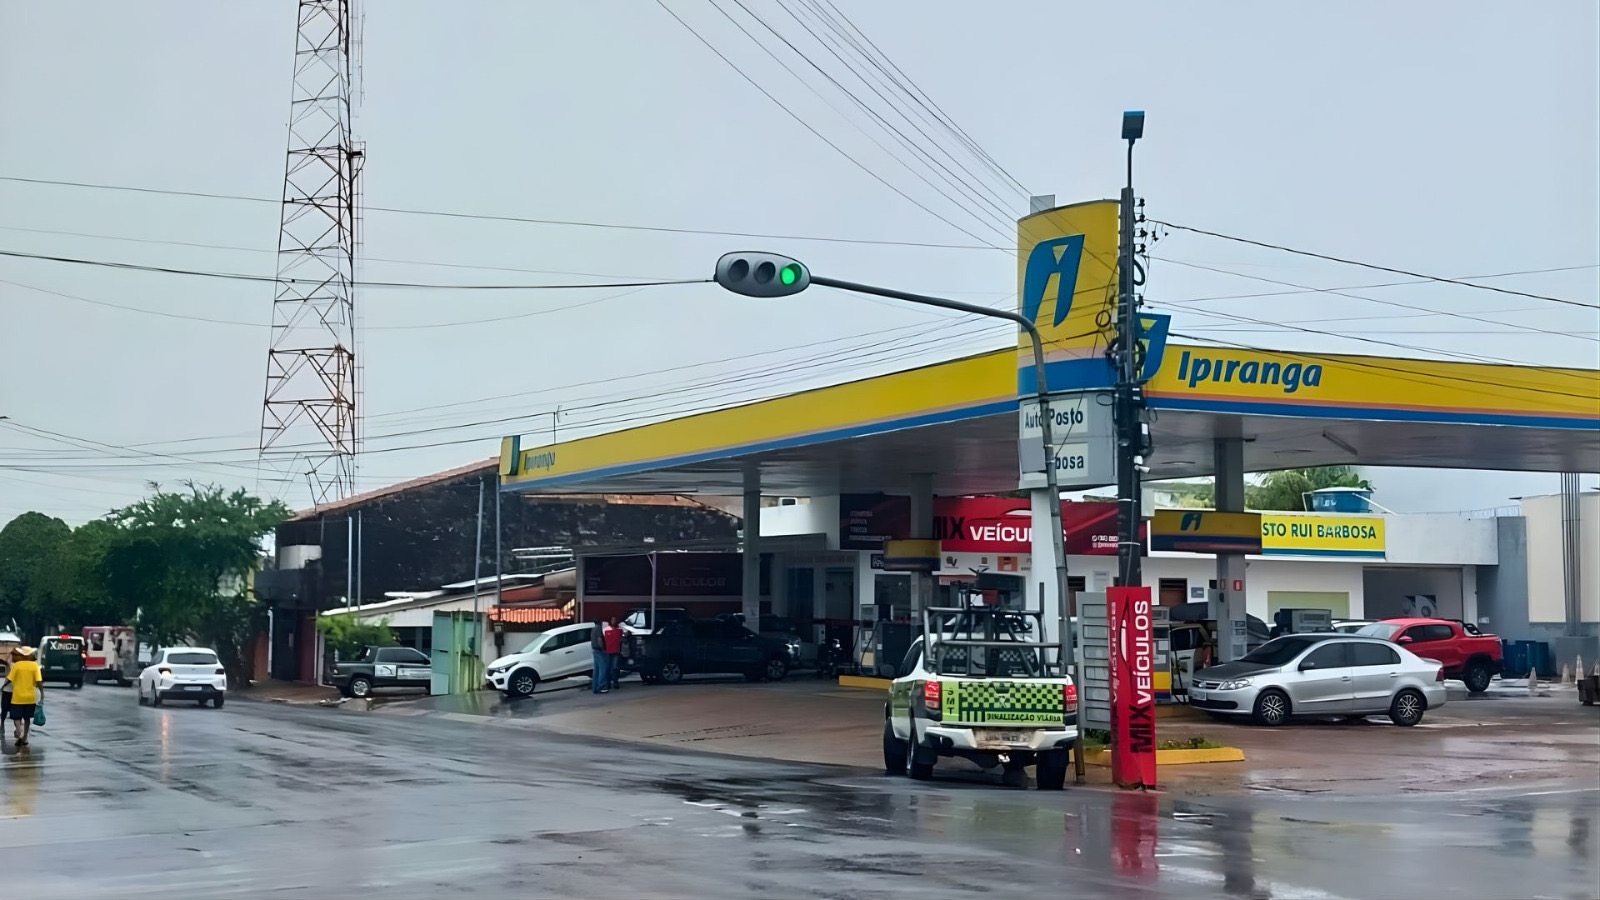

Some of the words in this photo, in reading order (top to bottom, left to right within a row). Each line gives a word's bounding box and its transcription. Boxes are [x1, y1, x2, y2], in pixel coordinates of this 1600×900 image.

[1177, 351, 1322, 393] Ipiranga
[1291, 524, 1312, 537] RUI
[1317, 525, 1377, 539] BARBOSA
[1132, 600, 1151, 705] VEÍCULOS
[1129, 704, 1152, 754] MIX
